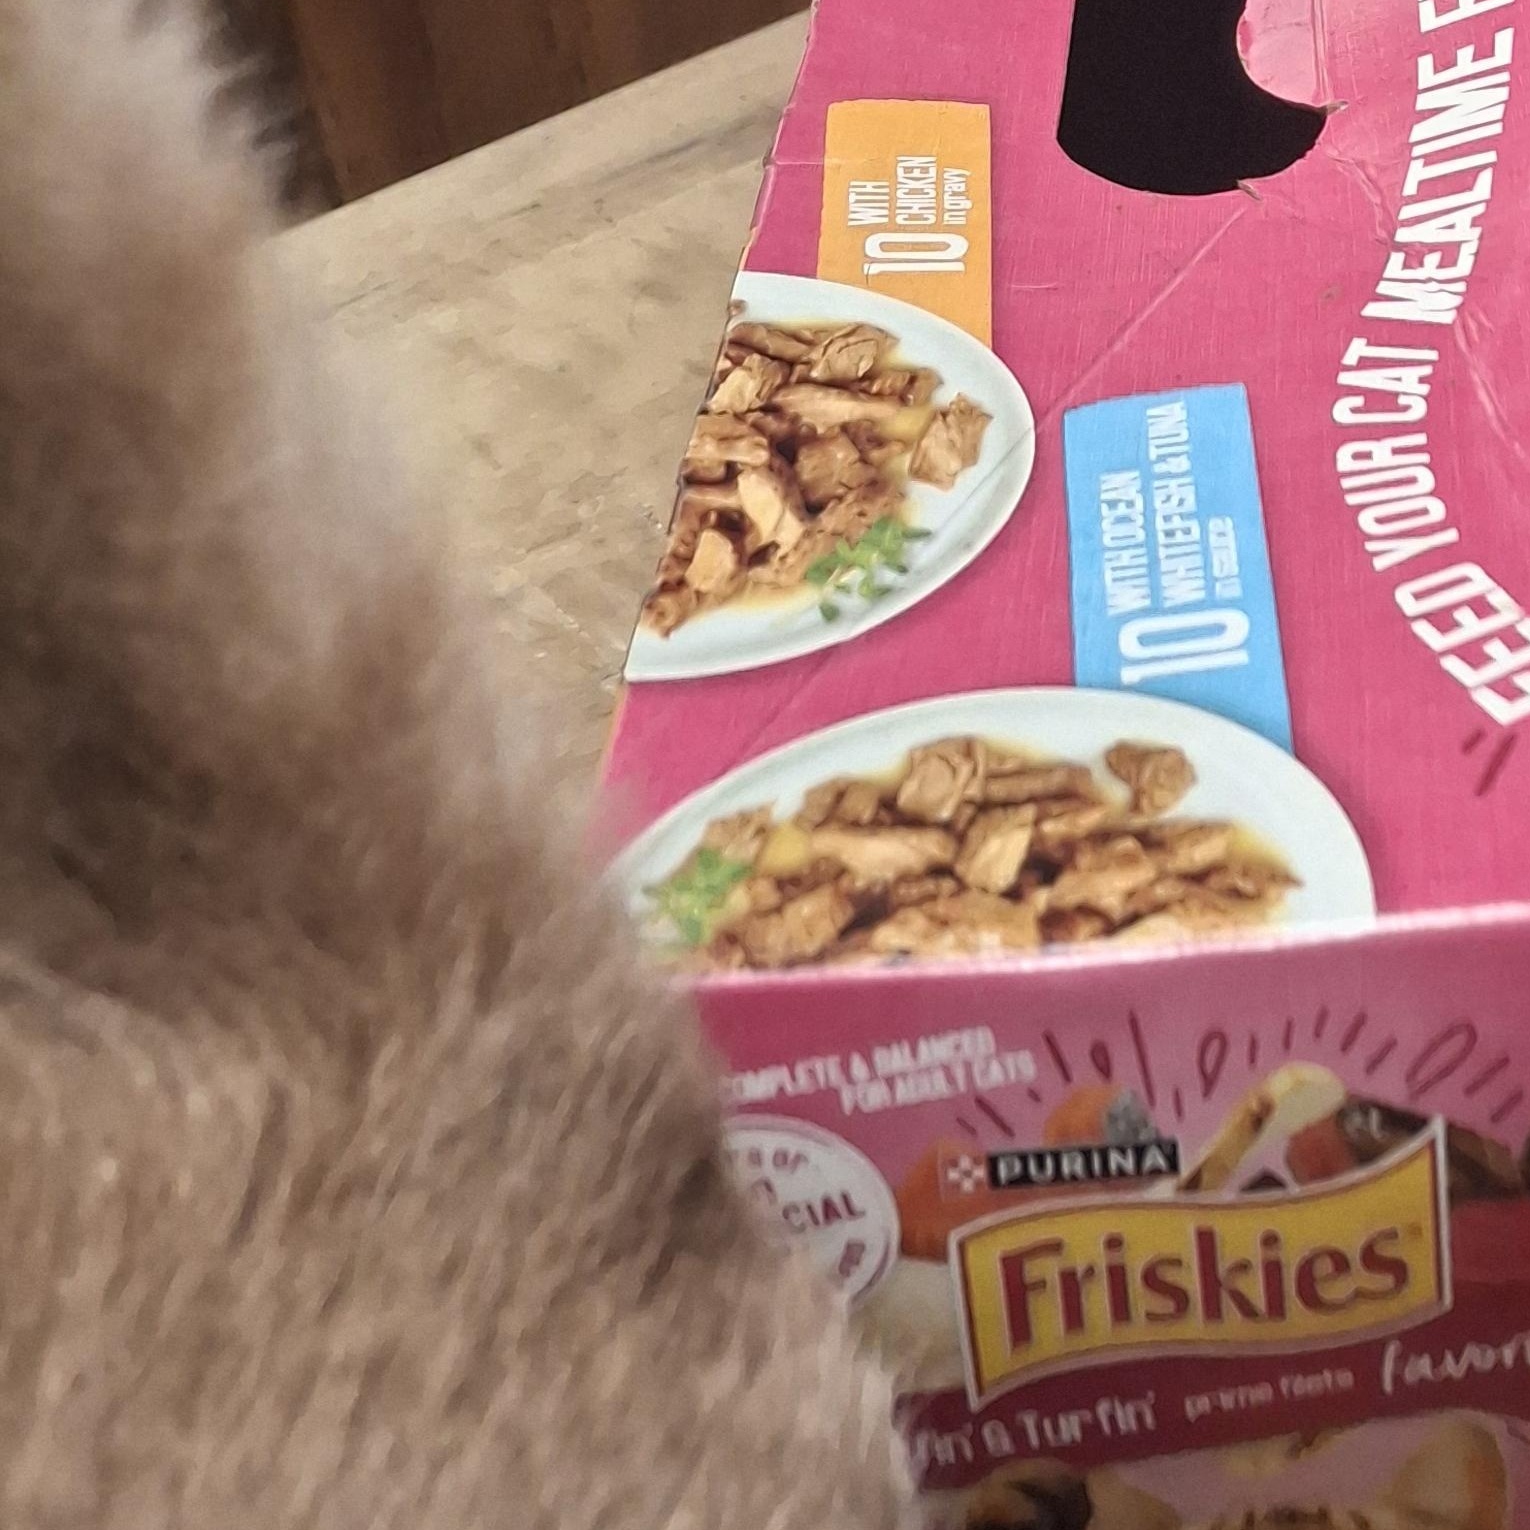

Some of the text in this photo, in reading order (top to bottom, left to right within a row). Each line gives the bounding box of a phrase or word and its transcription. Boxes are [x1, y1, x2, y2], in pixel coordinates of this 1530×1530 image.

[847, 180, 890, 226] WITH
[895, 156, 938, 225] CHICKEN
[943, 167, 973, 225] in gravy
[1359, 26, 1516, 325] MEALTIME
[863, 232, 970, 275] 10
[1331, 336, 1440, 425] CAT
[1146, 400, 1191, 461] TUNA
[1152, 475, 1206, 608] WHITEFISH
[1335, 432, 1461, 572] YOUR
[1099, 469, 1151, 616] WITH OCEAN
[1117, 607, 1250, 686] 10
[996, 1141, 1167, 1186] PURINA
[1000, 1222, 1411, 1352] Friskies
